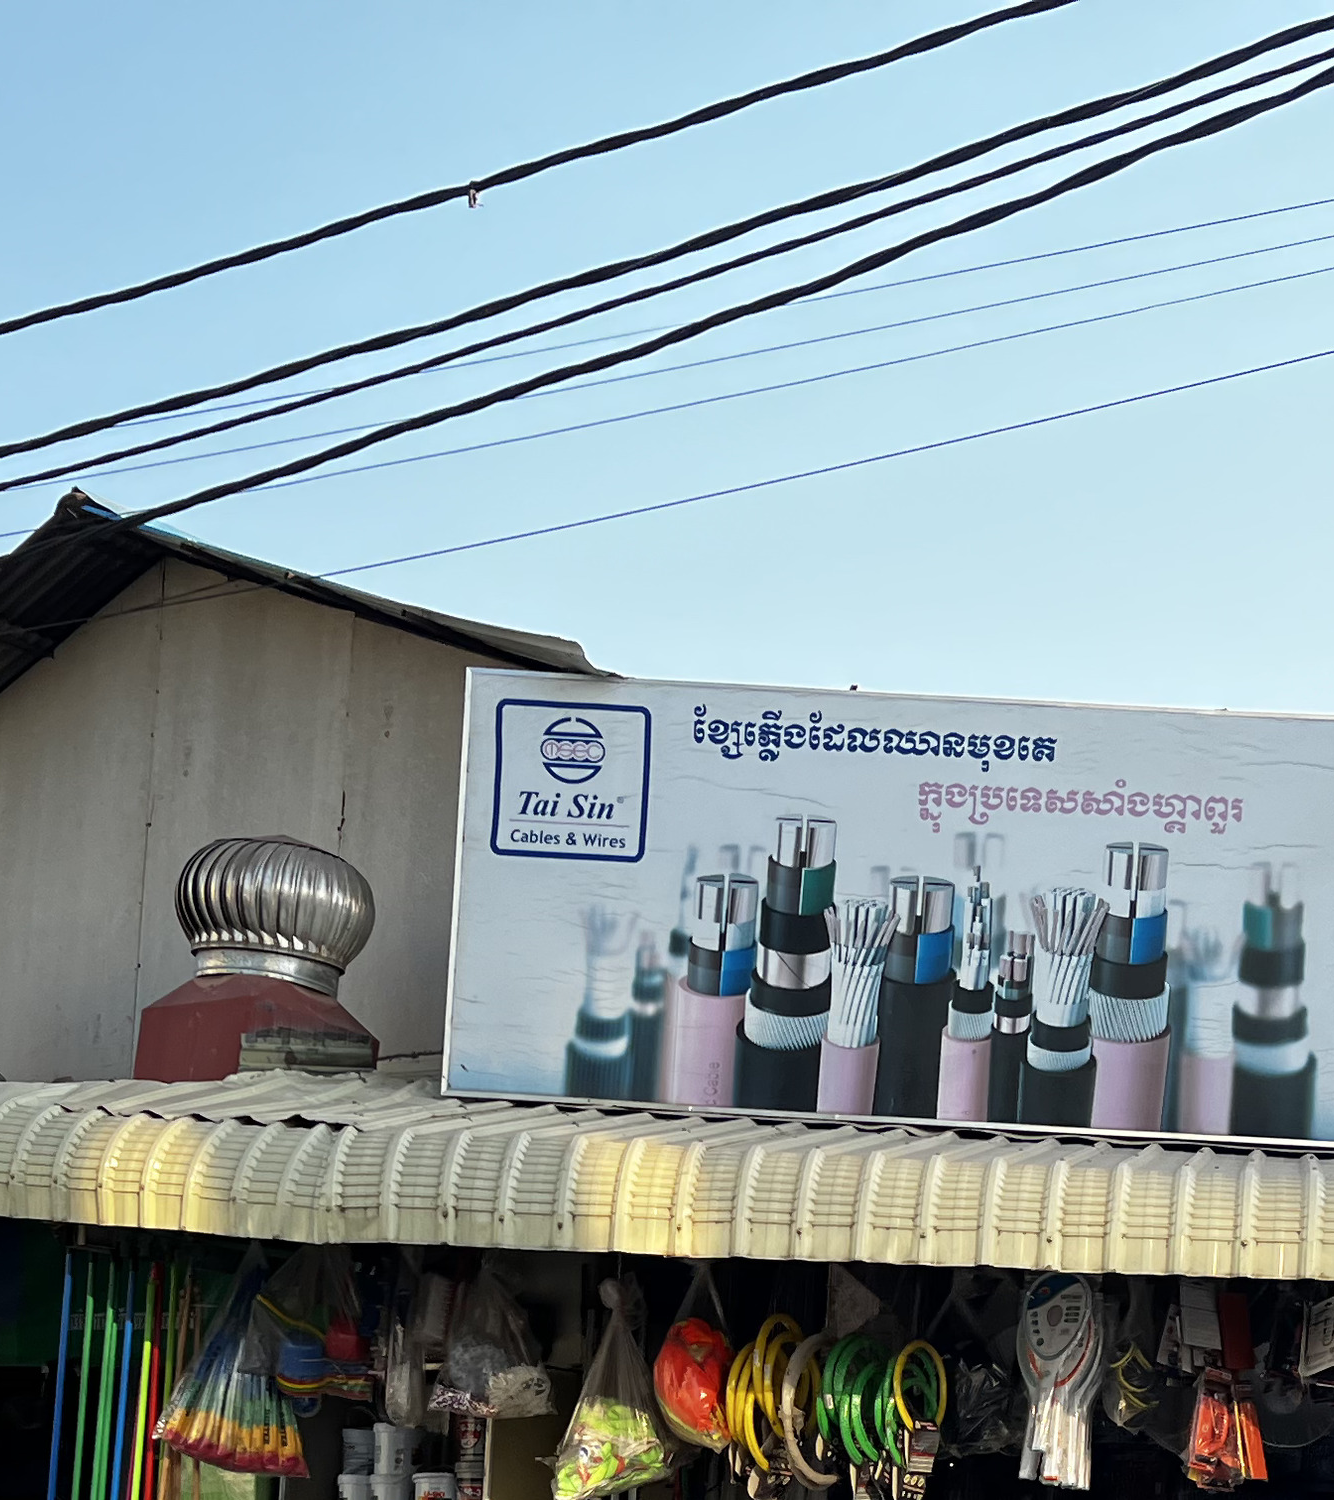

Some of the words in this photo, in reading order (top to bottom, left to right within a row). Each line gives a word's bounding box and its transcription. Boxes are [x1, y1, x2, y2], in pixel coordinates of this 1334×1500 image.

[518, 791, 562, 816] Tai
[567, 794, 616, 820] Sin
[510, 828, 560, 845] Cables
[565, 832, 577, 846] &
[582, 833, 627, 849] Wires
